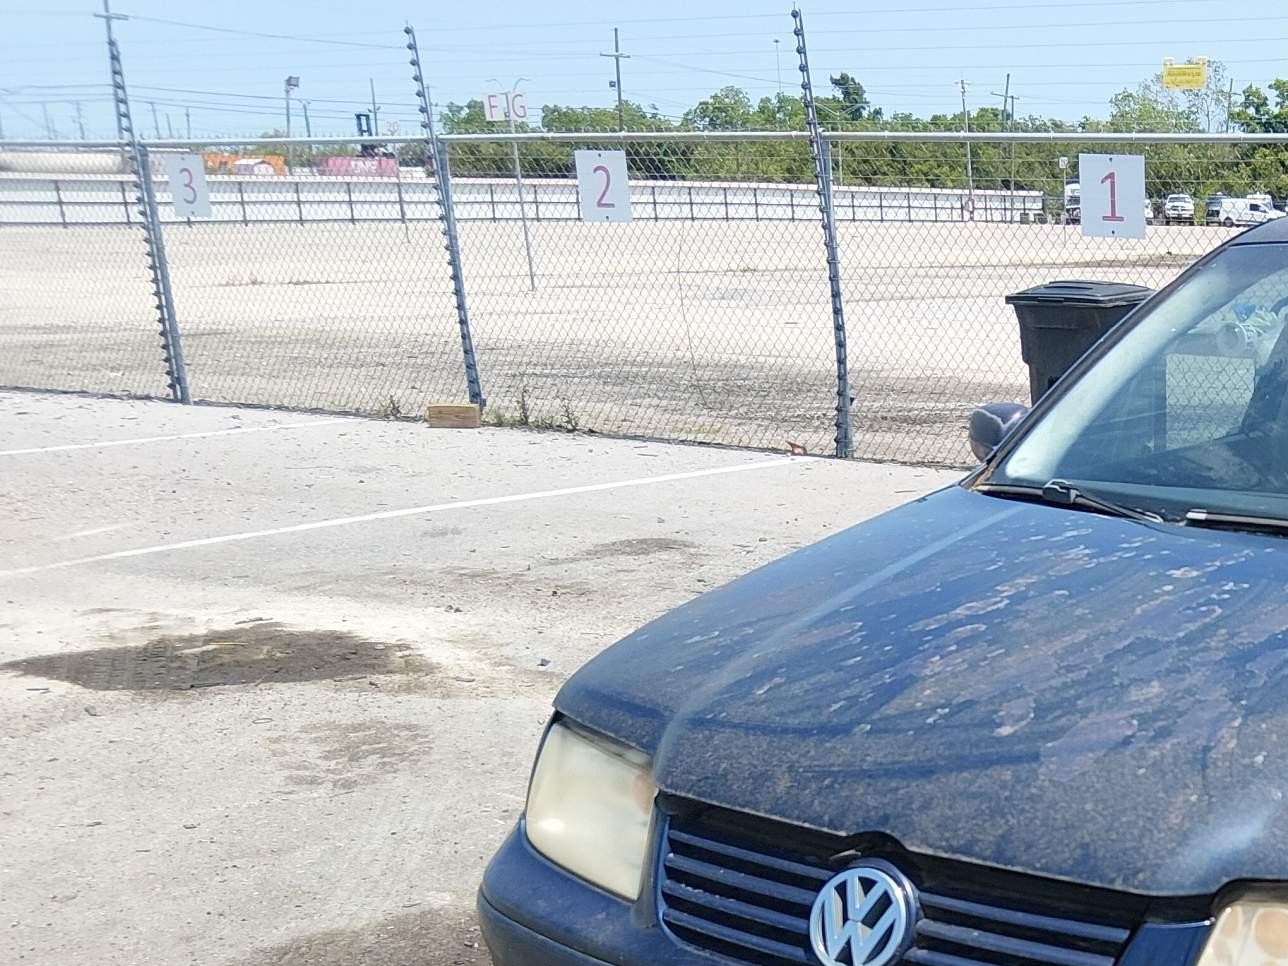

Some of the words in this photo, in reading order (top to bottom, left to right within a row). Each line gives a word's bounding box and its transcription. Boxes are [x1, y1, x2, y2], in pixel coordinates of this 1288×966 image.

[487, 94, 498, 119] F
[511, 93, 527, 119] G
[179, 168, 198, 204] 3
[592, 165, 616, 208] 2
[1101, 171, 1125, 222] 1
